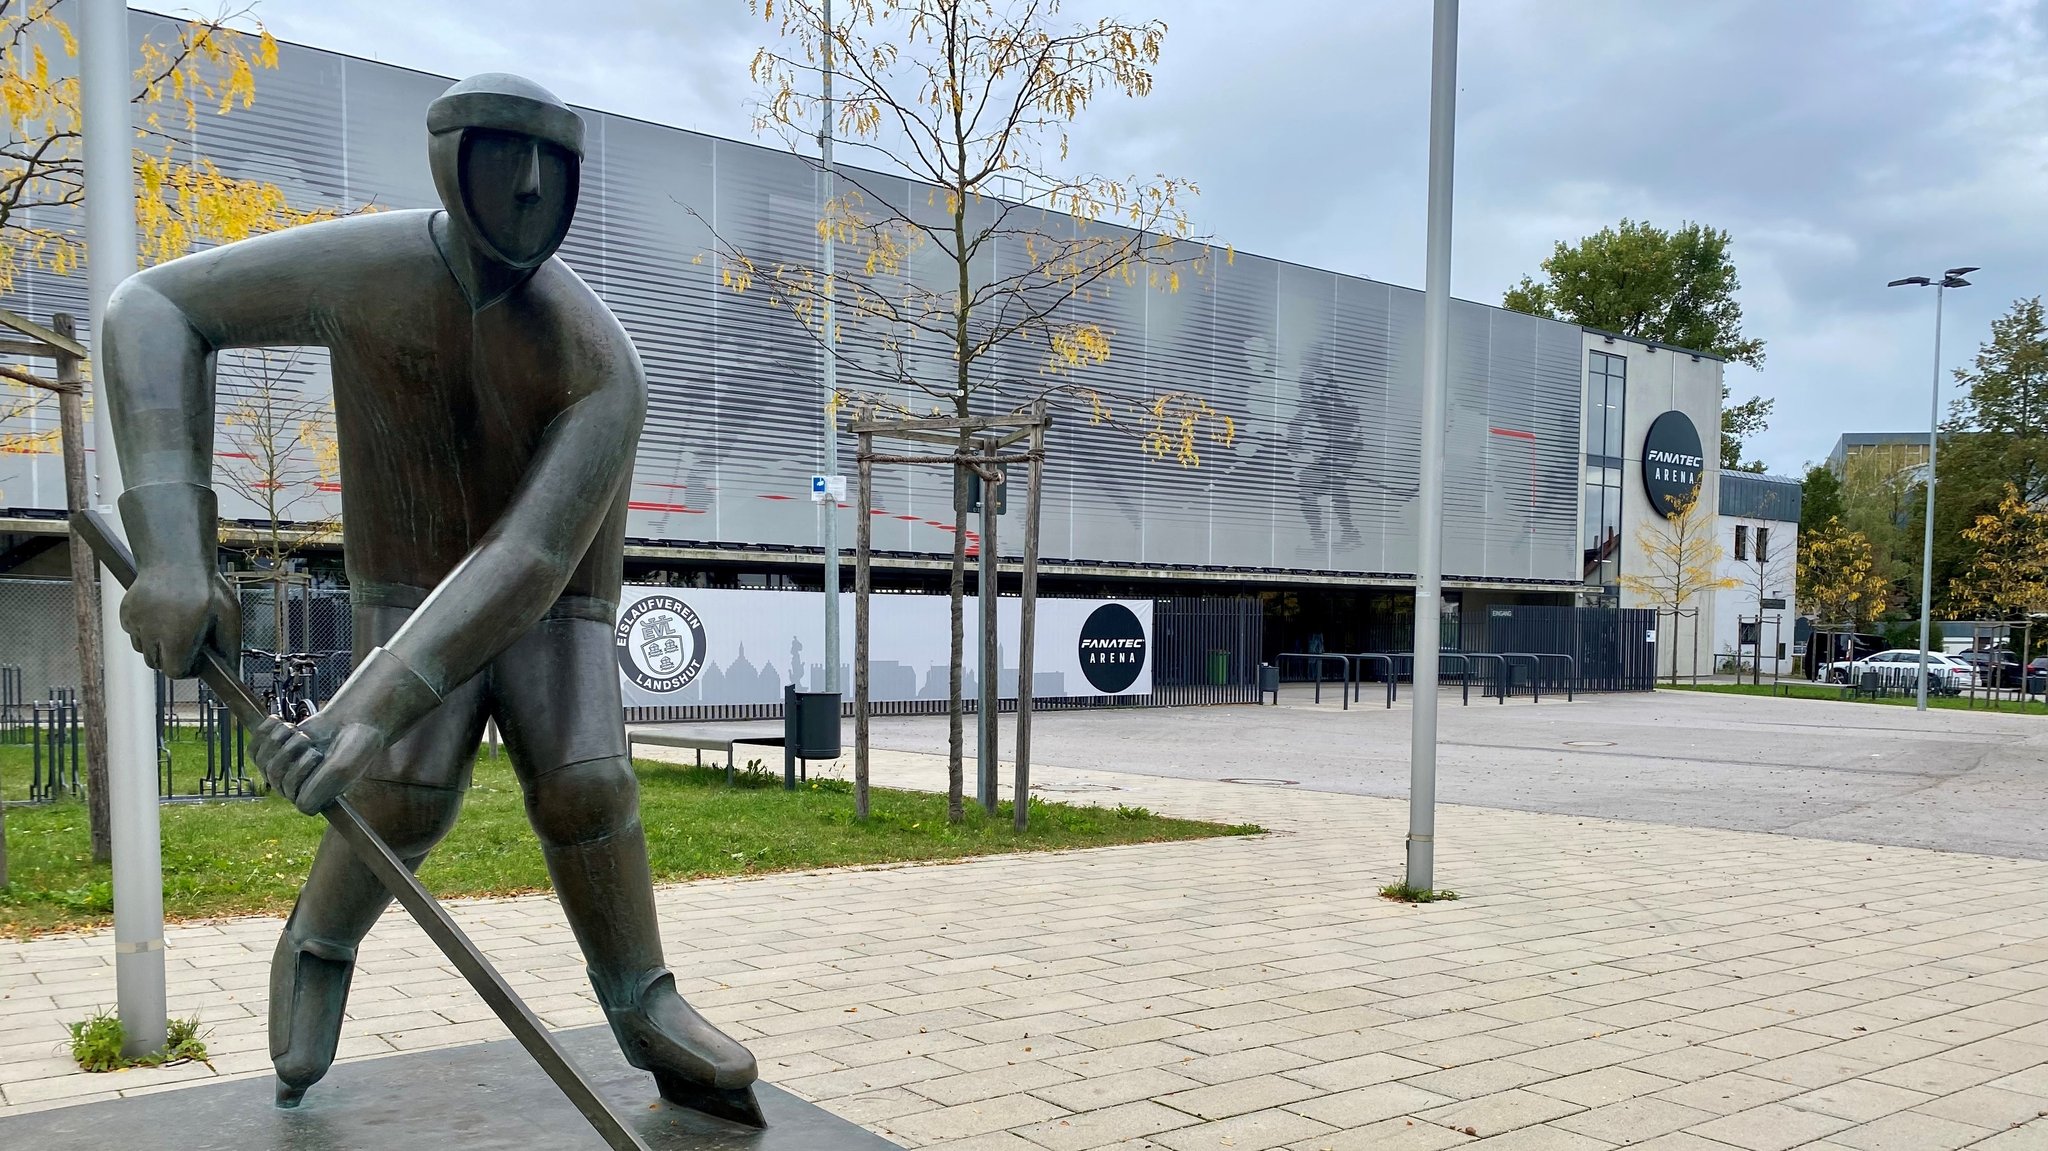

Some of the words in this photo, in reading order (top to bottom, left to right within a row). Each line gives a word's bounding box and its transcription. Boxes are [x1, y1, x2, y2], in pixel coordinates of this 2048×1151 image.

[1648, 450, 1701, 467] FANATEC
[1655, 467, 1694, 484] ARENA
[616, 598, 700, 647] EISLAUFVEREIN
[641, 620, 676, 640] EVL
[1081, 639, 1142, 648] FANATEC
[1090, 652, 1135, 663] ARENA
[635, 659, 700, 690] LANDSHUT
